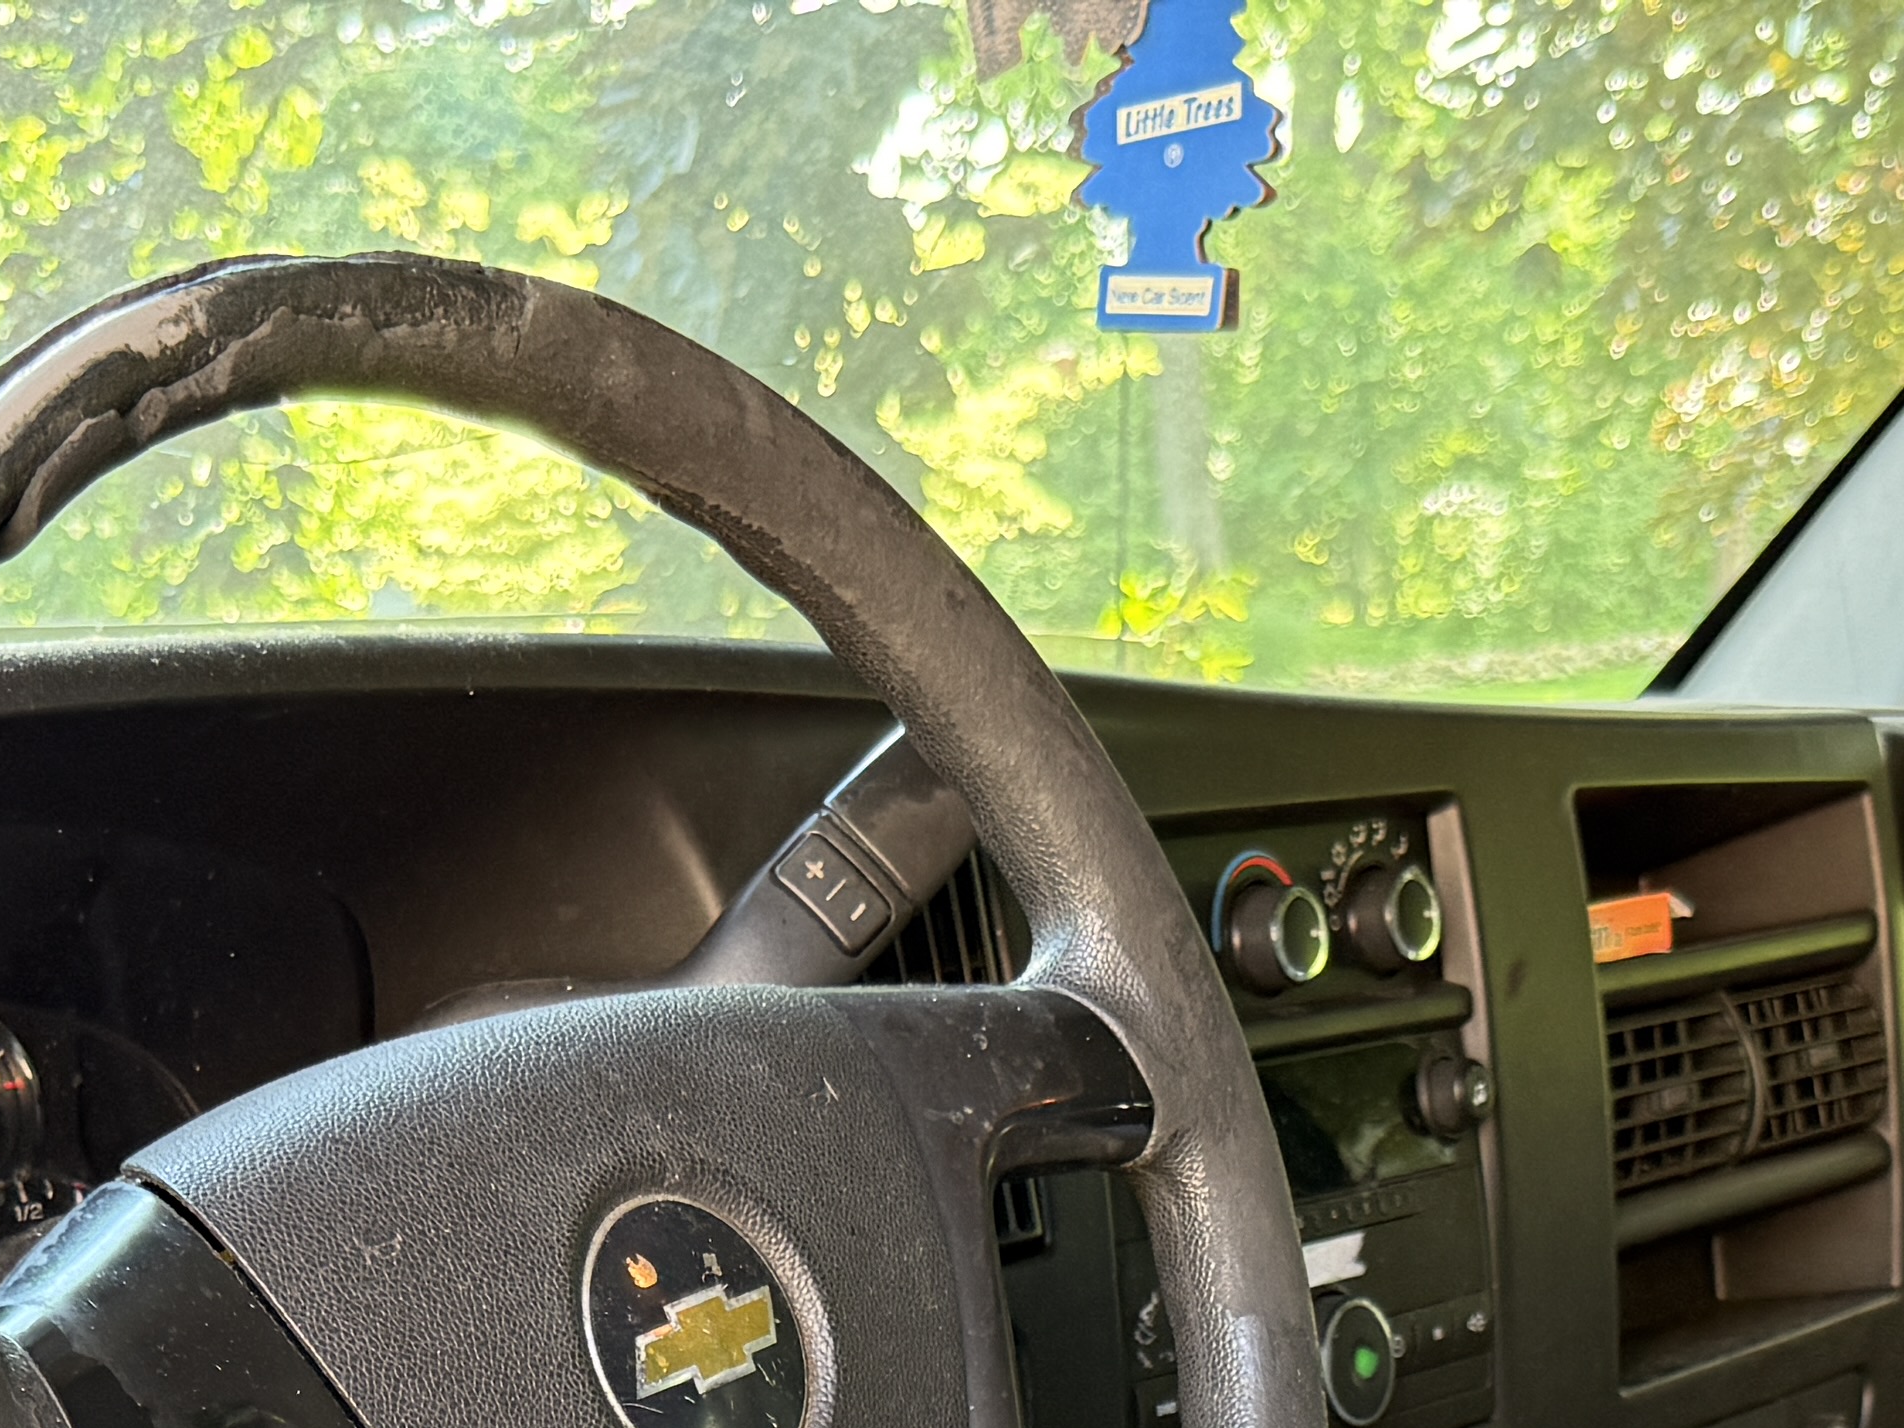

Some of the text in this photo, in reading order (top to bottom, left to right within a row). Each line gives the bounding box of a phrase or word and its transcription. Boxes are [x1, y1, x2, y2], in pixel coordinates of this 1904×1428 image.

[1124, 94, 1236, 138] Little Trees
[1142, 287, 1164, 304] Car
[1167, 286, 1206, 306] Scent
[14, 1202, 44, 1222] 1/2
